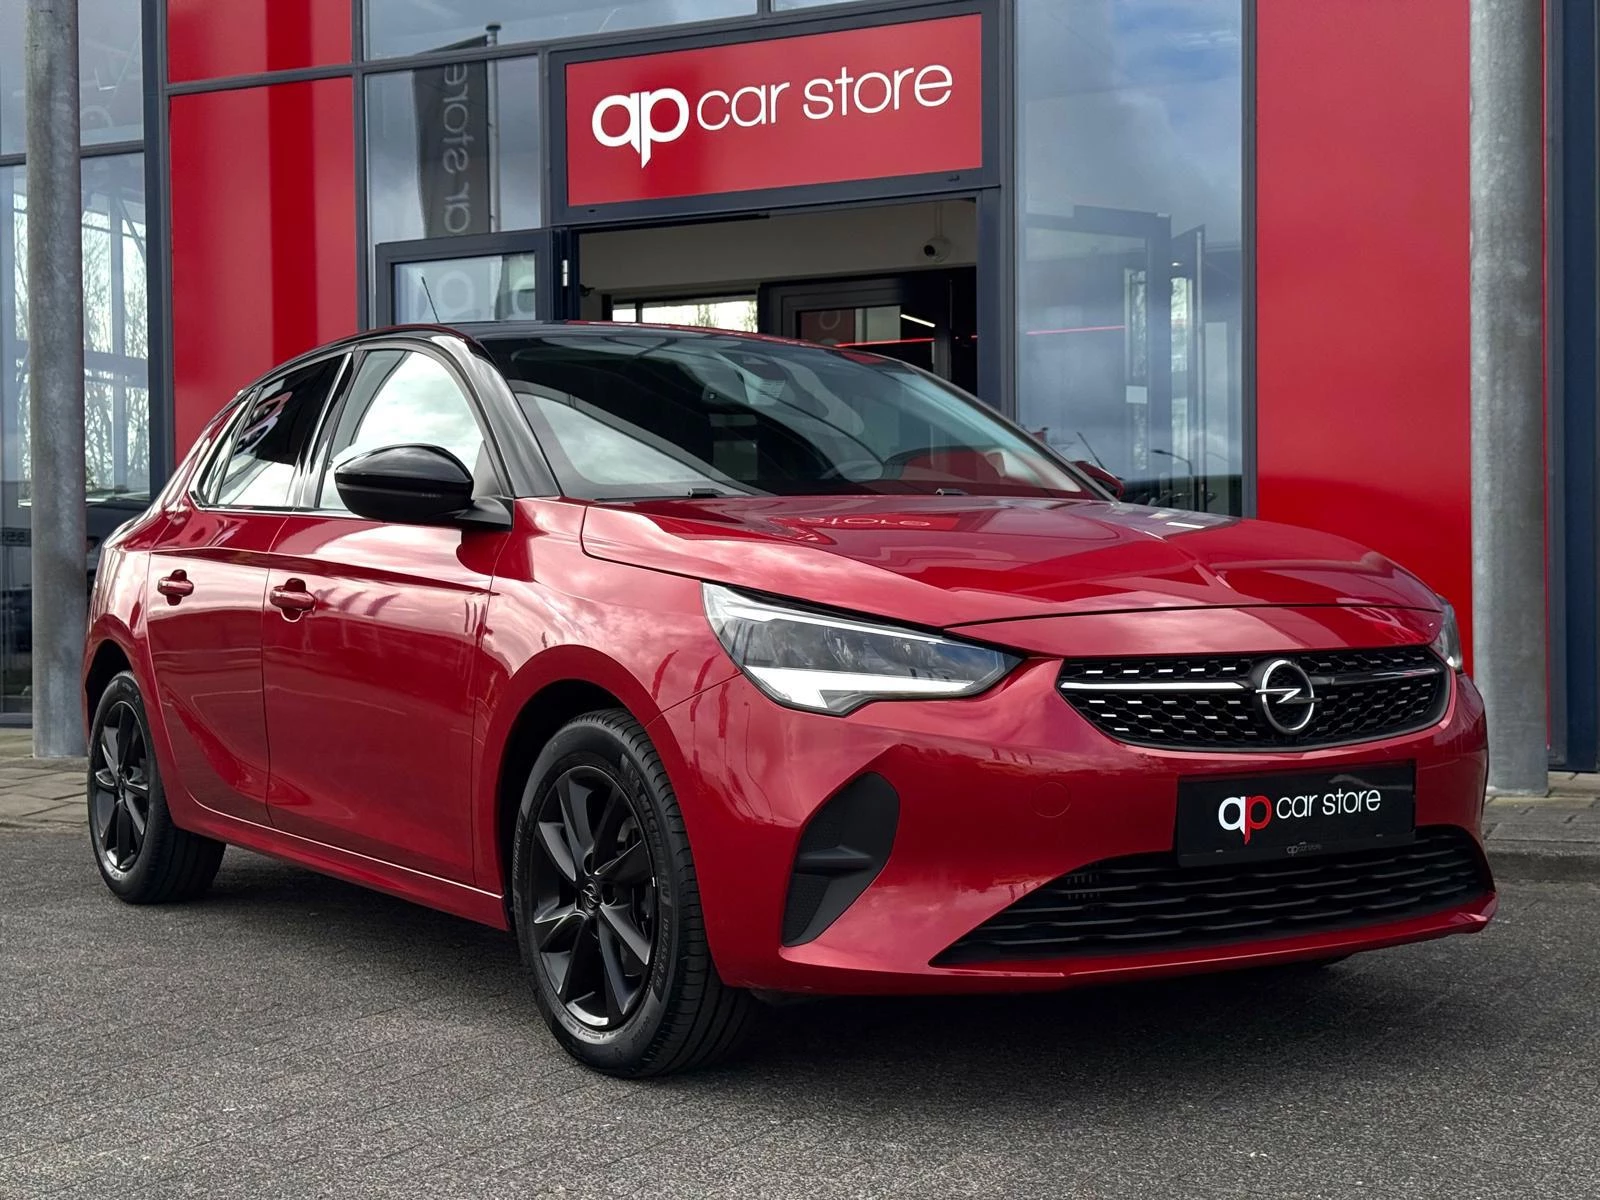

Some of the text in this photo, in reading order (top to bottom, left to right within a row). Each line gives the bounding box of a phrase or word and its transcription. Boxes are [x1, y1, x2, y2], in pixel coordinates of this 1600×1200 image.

[591, 64, 953, 169] ap car store
[1217, 787, 1382, 845] ap car store
